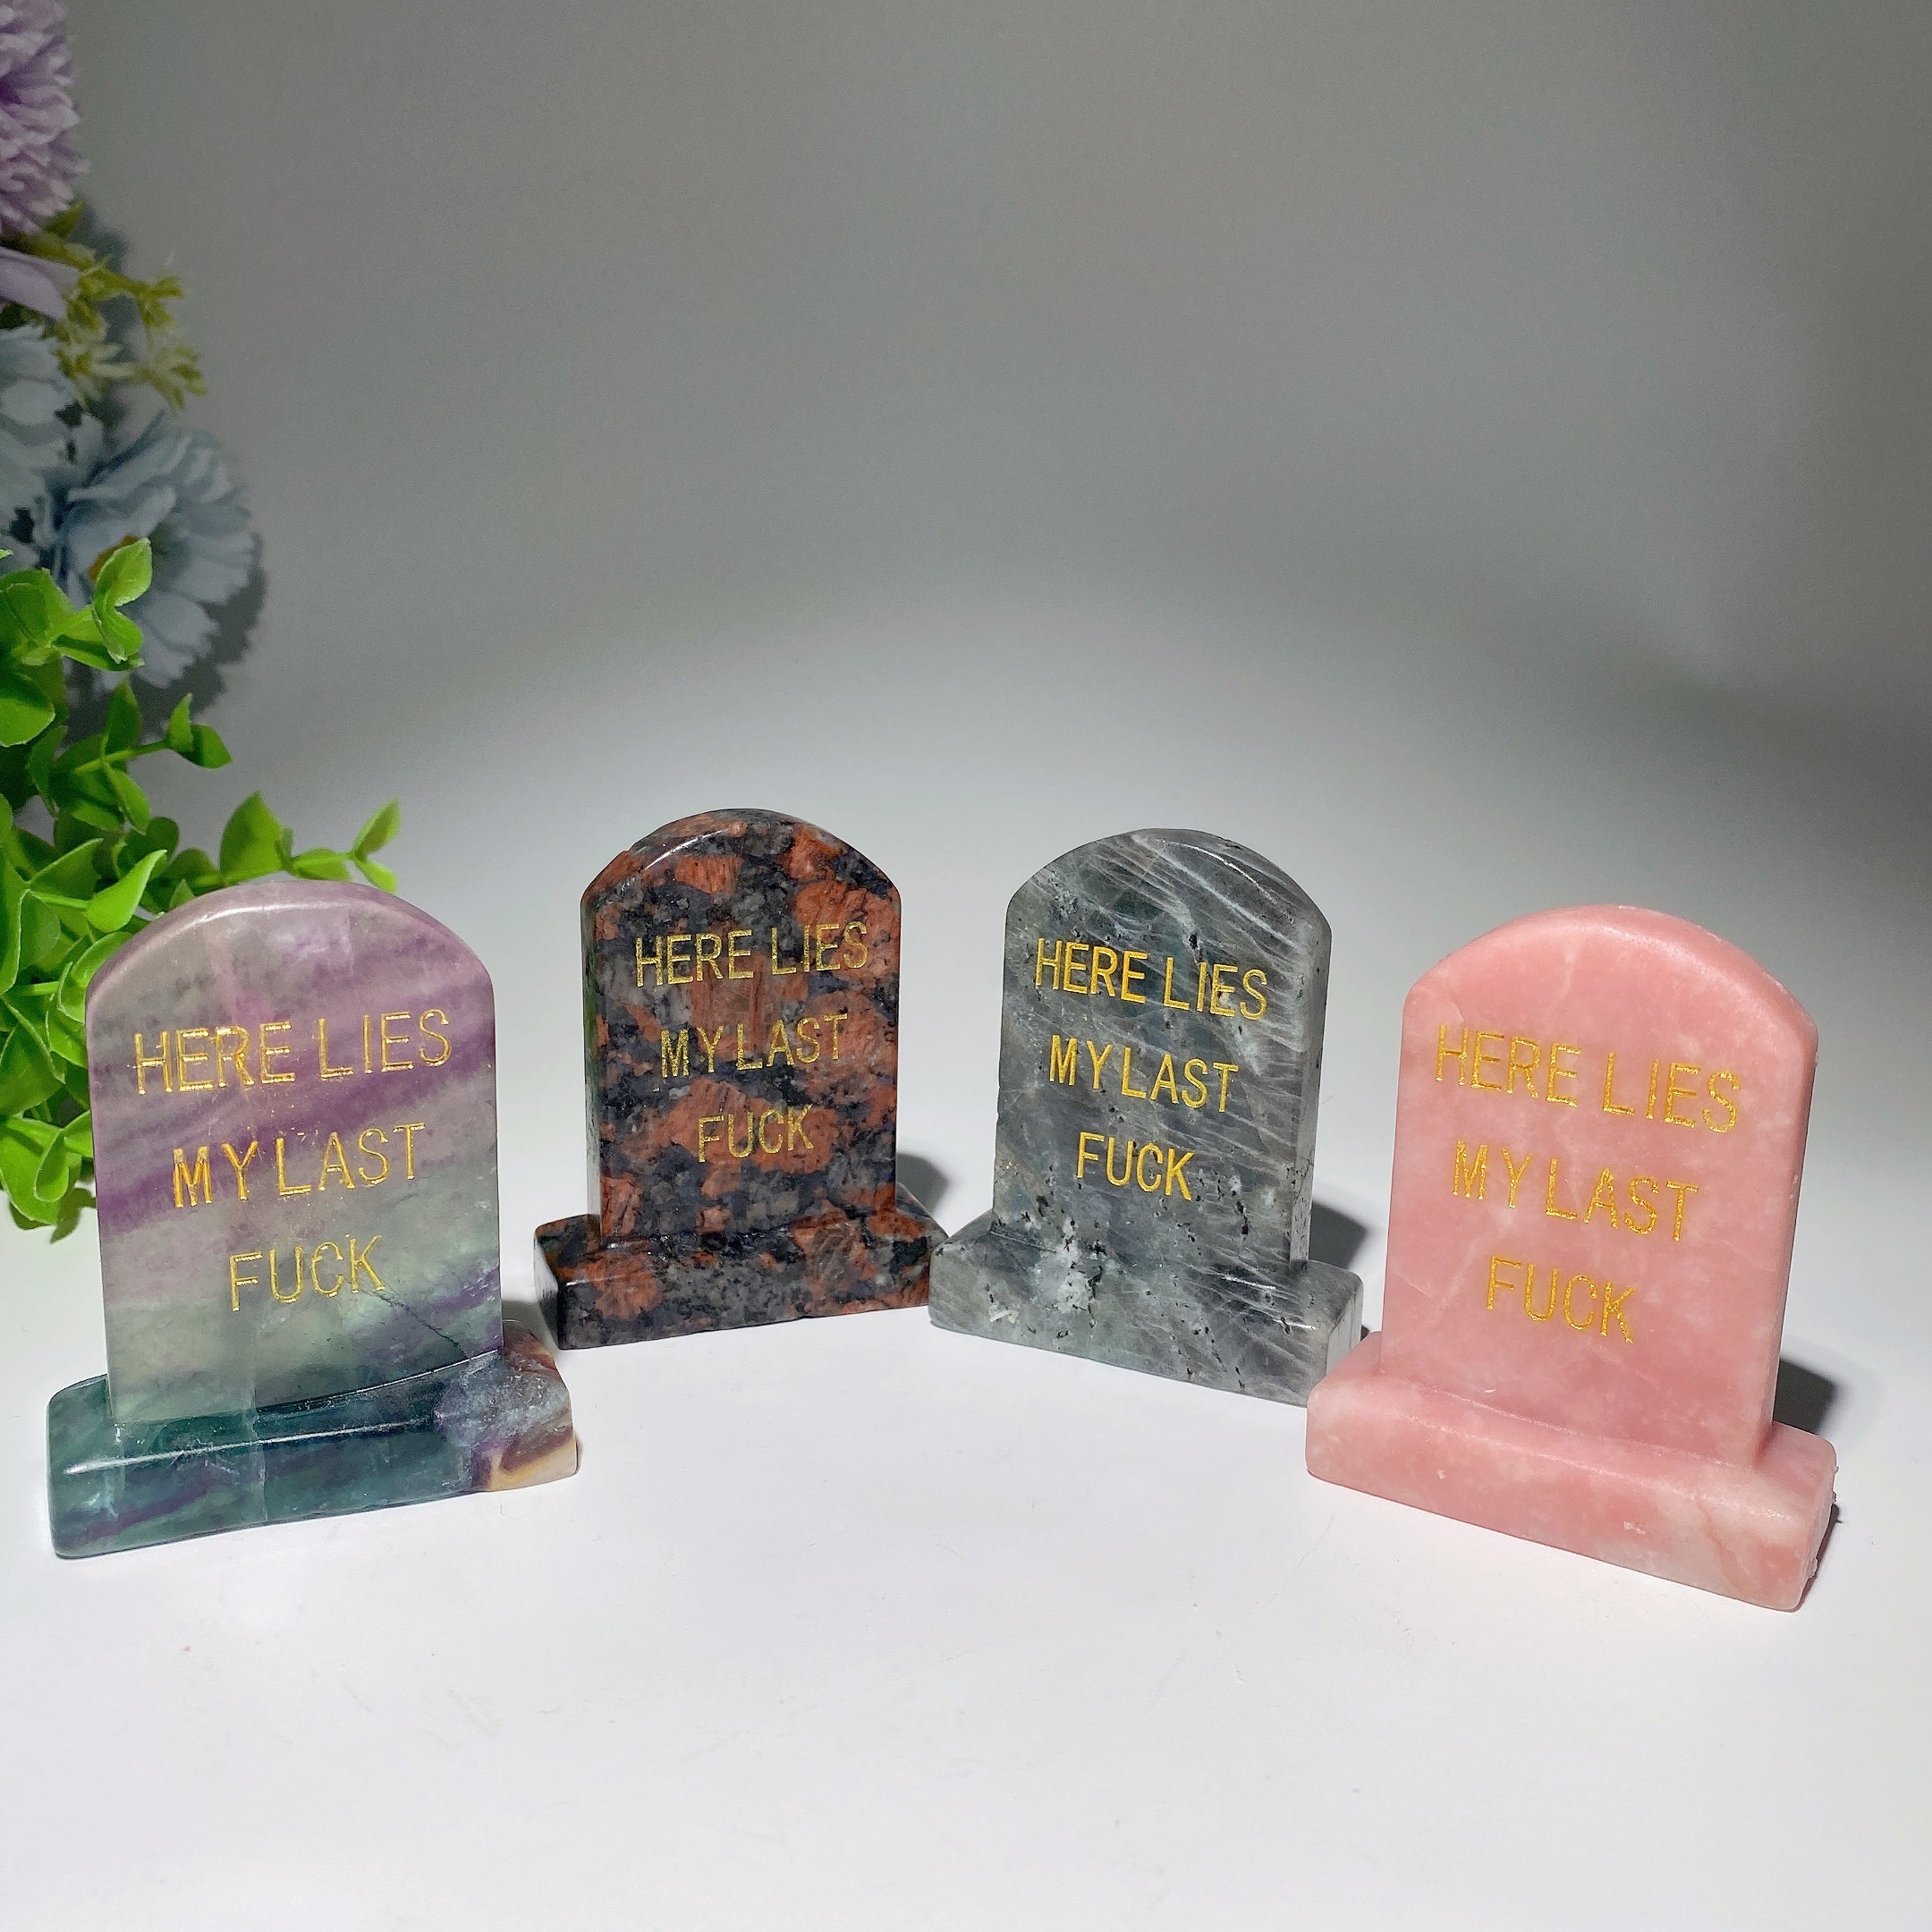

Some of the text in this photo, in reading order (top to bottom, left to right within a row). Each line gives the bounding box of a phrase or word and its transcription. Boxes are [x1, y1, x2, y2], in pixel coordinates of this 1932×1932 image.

[635, 920, 869, 987] HERE LIES
[1034, 937, 1267, 1021] HERE LIES
[133, 1008, 453, 1095] HERE LIES
[660, 1013, 848, 1079] MY LAST
[1048, 1034, 1239, 1114] MY LAST
[1434, 1024, 1741, 1134] HERE LIES
[172, 1123, 426, 1208] MY LAST
[698, 1105, 815, 1163] FUCK
[1075, 1131, 1194, 1201] FUCK
[1451, 1140, 1699, 1242] MY LAST
[229, 1234, 386, 1312] FUCK
[1486, 1257, 1637, 1344] FUCK
